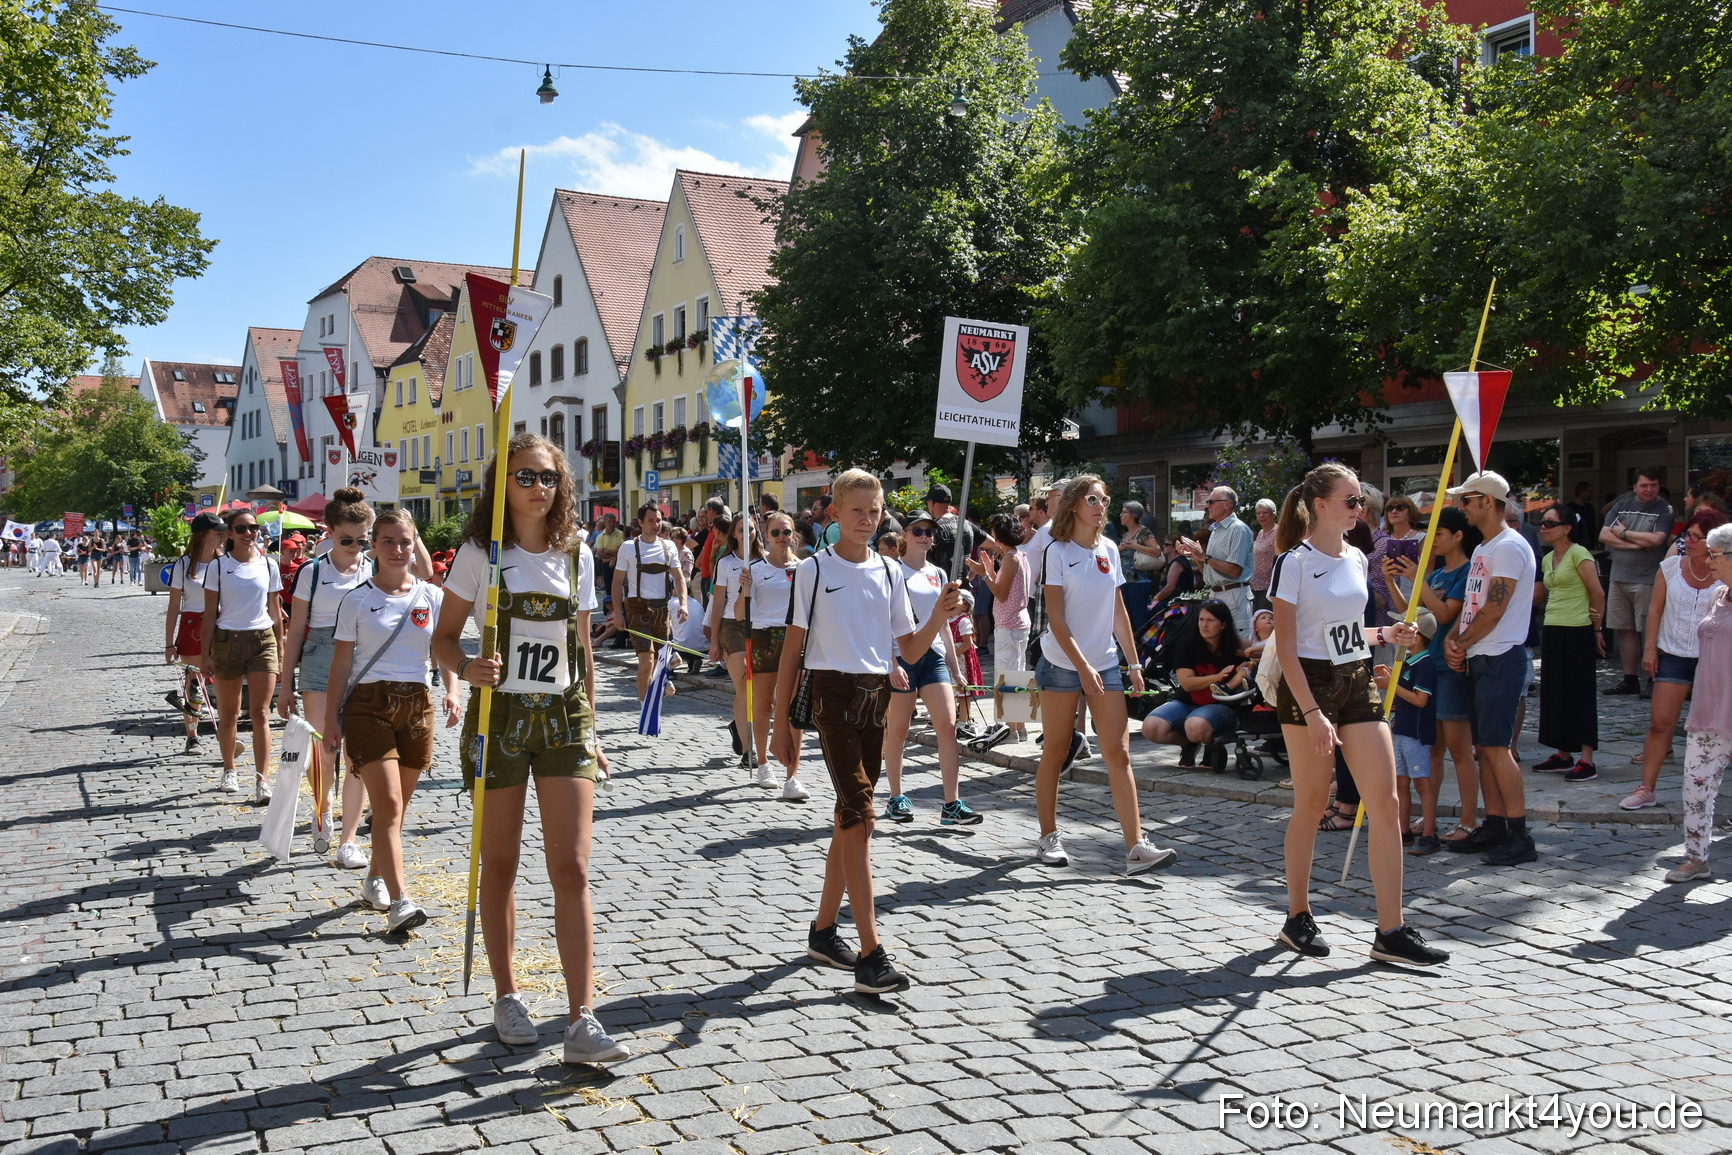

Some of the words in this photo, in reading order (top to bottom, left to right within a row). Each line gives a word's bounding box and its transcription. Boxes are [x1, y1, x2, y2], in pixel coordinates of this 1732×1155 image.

[499, 294, 514, 305] BLV
[481, 301, 533, 321] MITTELFRANKEN
[960, 325, 1014, 340] NEUMARKT
[966, 337, 977, 346] 18
[995, 341, 1006, 349] 60
[328, 349, 342, 374] K&L
[970, 350, 1001, 375] ASV
[402, 420, 417, 434] HOTEL
[938, 411, 1017, 429] LEICHTATHLETIK
[648, 473, 656, 489] P
[1329, 621, 1365, 656] 124
[516, 641, 560, 684] 112
